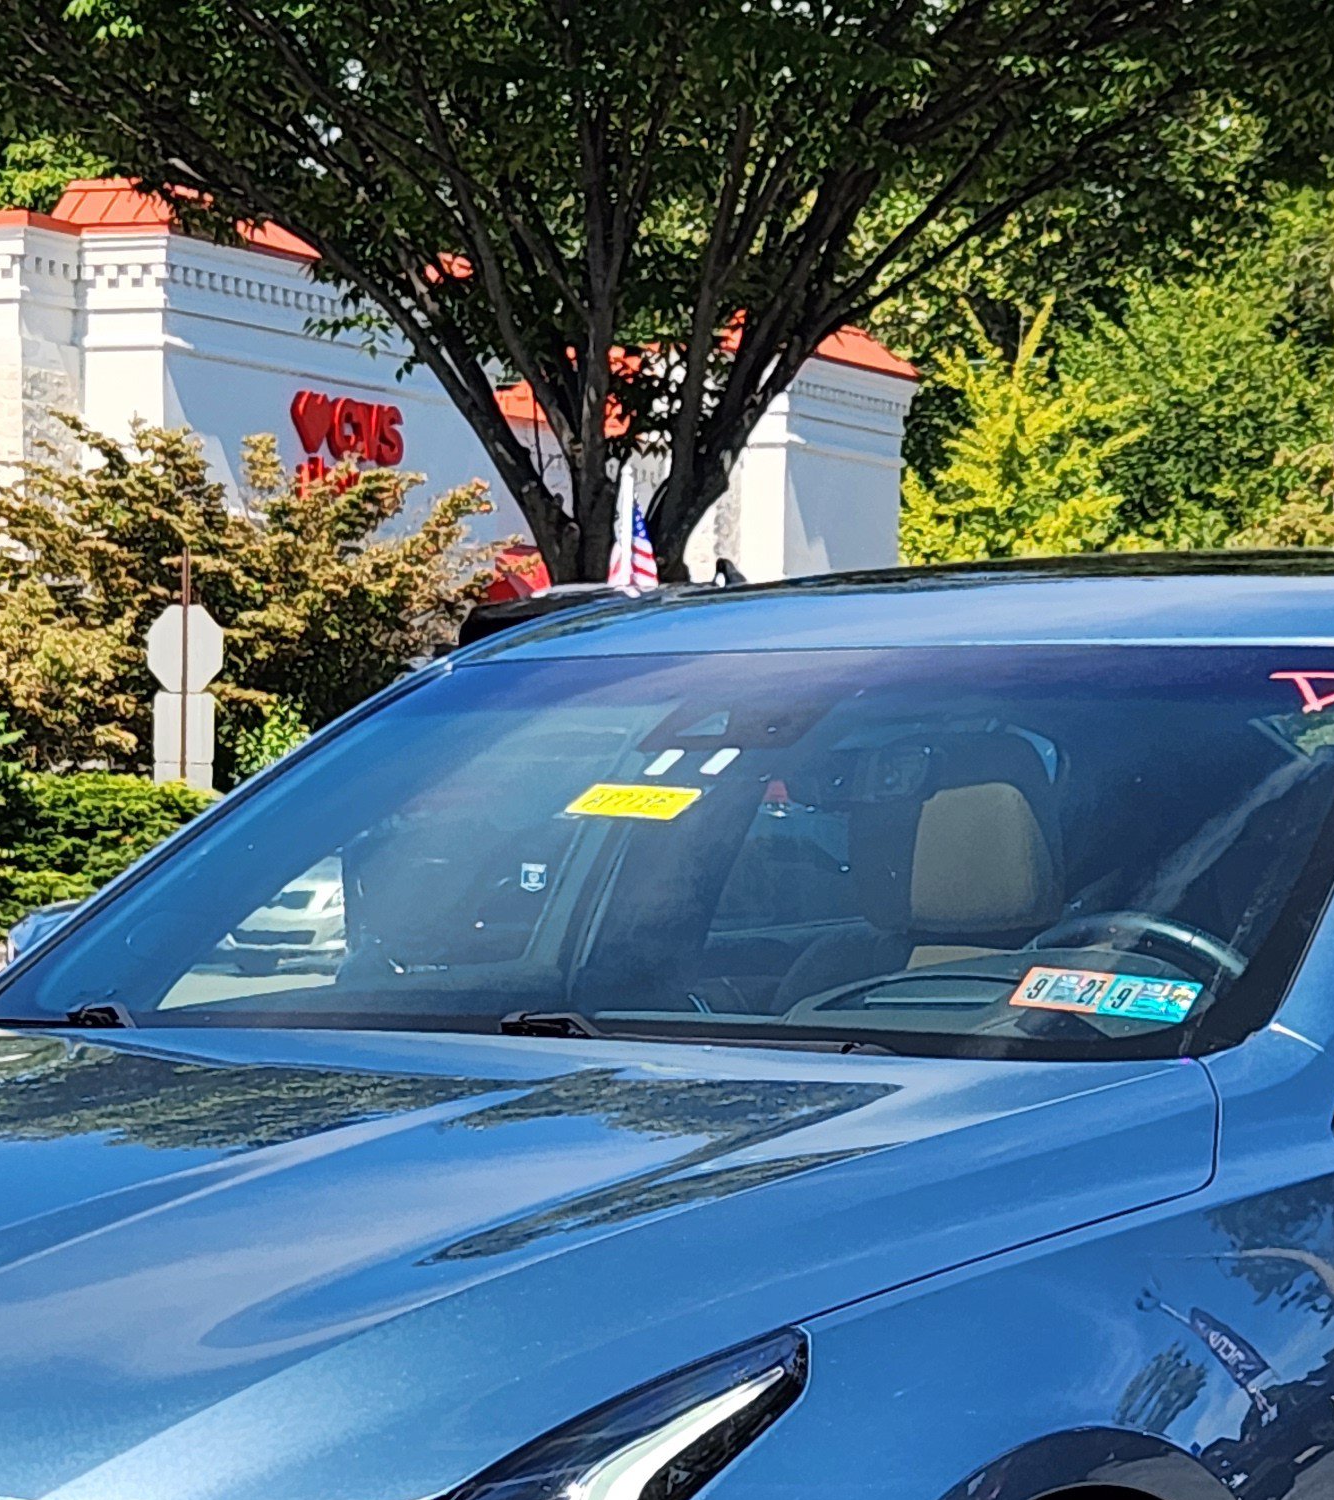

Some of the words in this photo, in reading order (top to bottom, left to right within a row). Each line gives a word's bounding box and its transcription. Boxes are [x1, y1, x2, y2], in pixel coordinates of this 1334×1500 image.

[326, 396, 404, 467] CVS
[1027, 978, 1049, 999] 9
[1110, 987, 1133, 1009] 9
